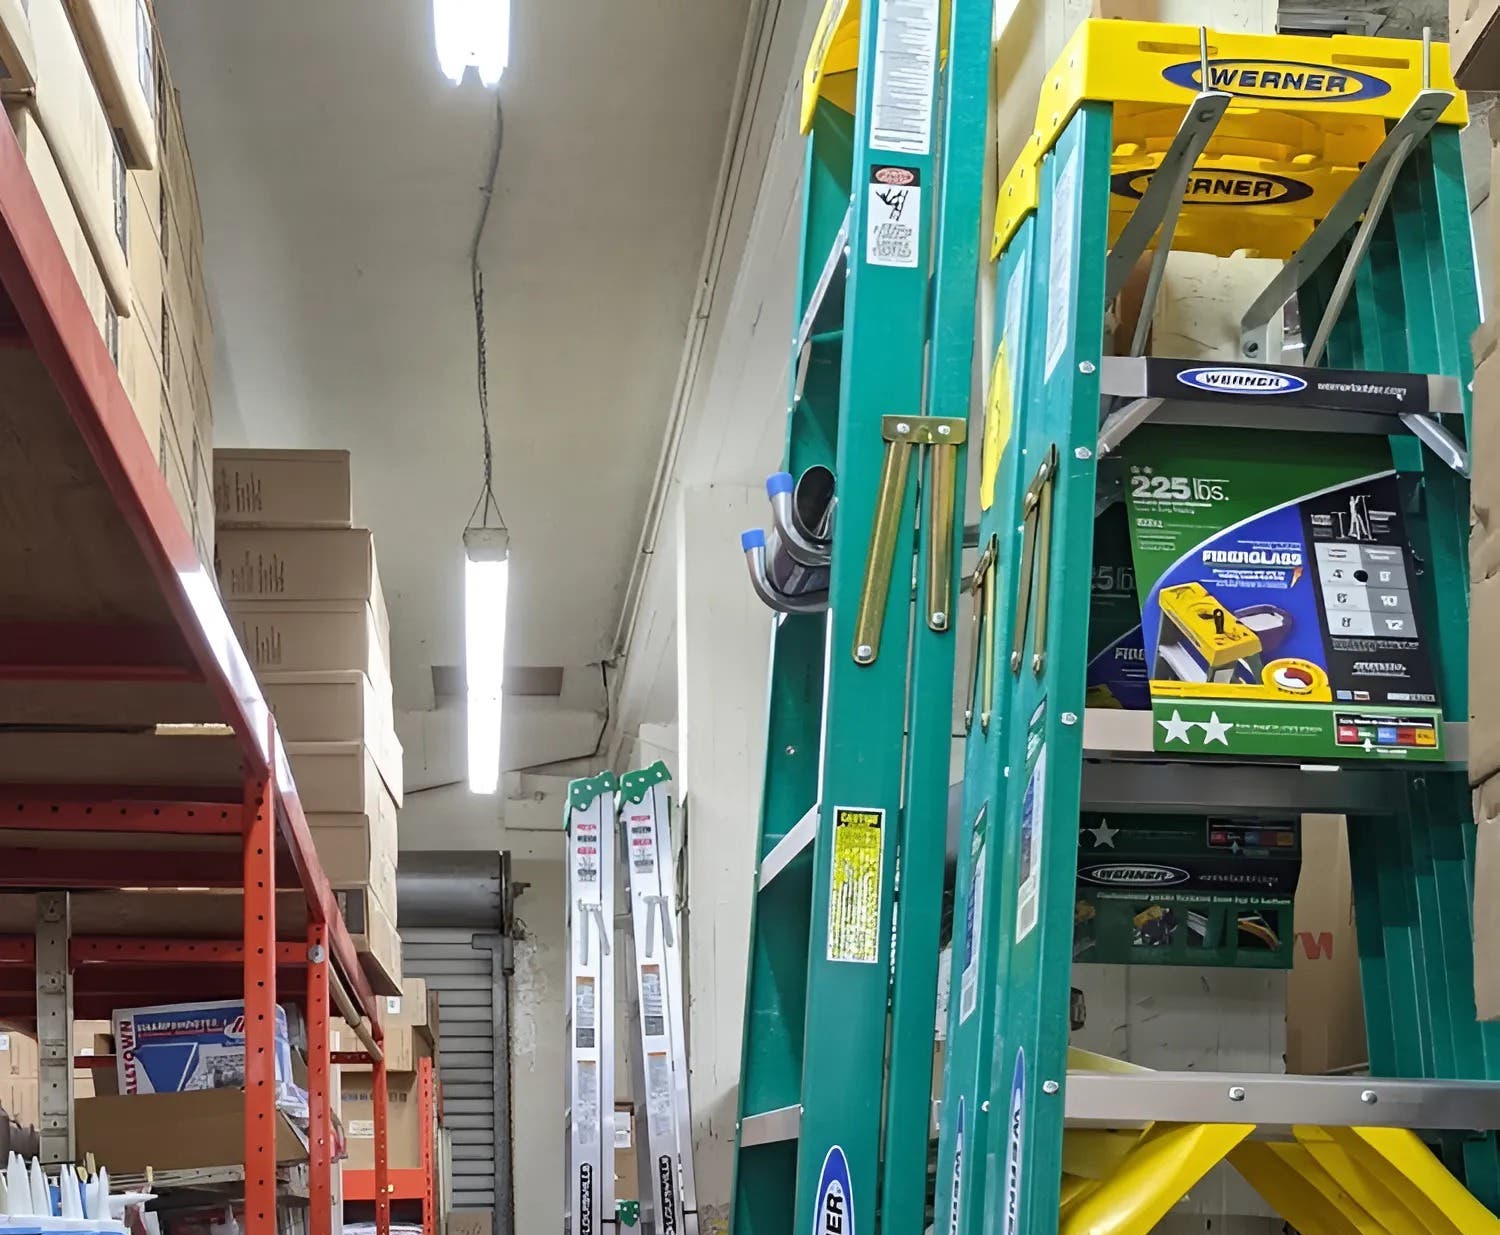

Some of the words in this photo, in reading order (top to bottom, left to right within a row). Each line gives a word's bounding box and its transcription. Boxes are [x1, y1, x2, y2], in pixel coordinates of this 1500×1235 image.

[1210, 66, 1347, 93] WERNER
[1131, 476, 1191, 500] 225
[1192, 478, 1230, 501] lbs.
